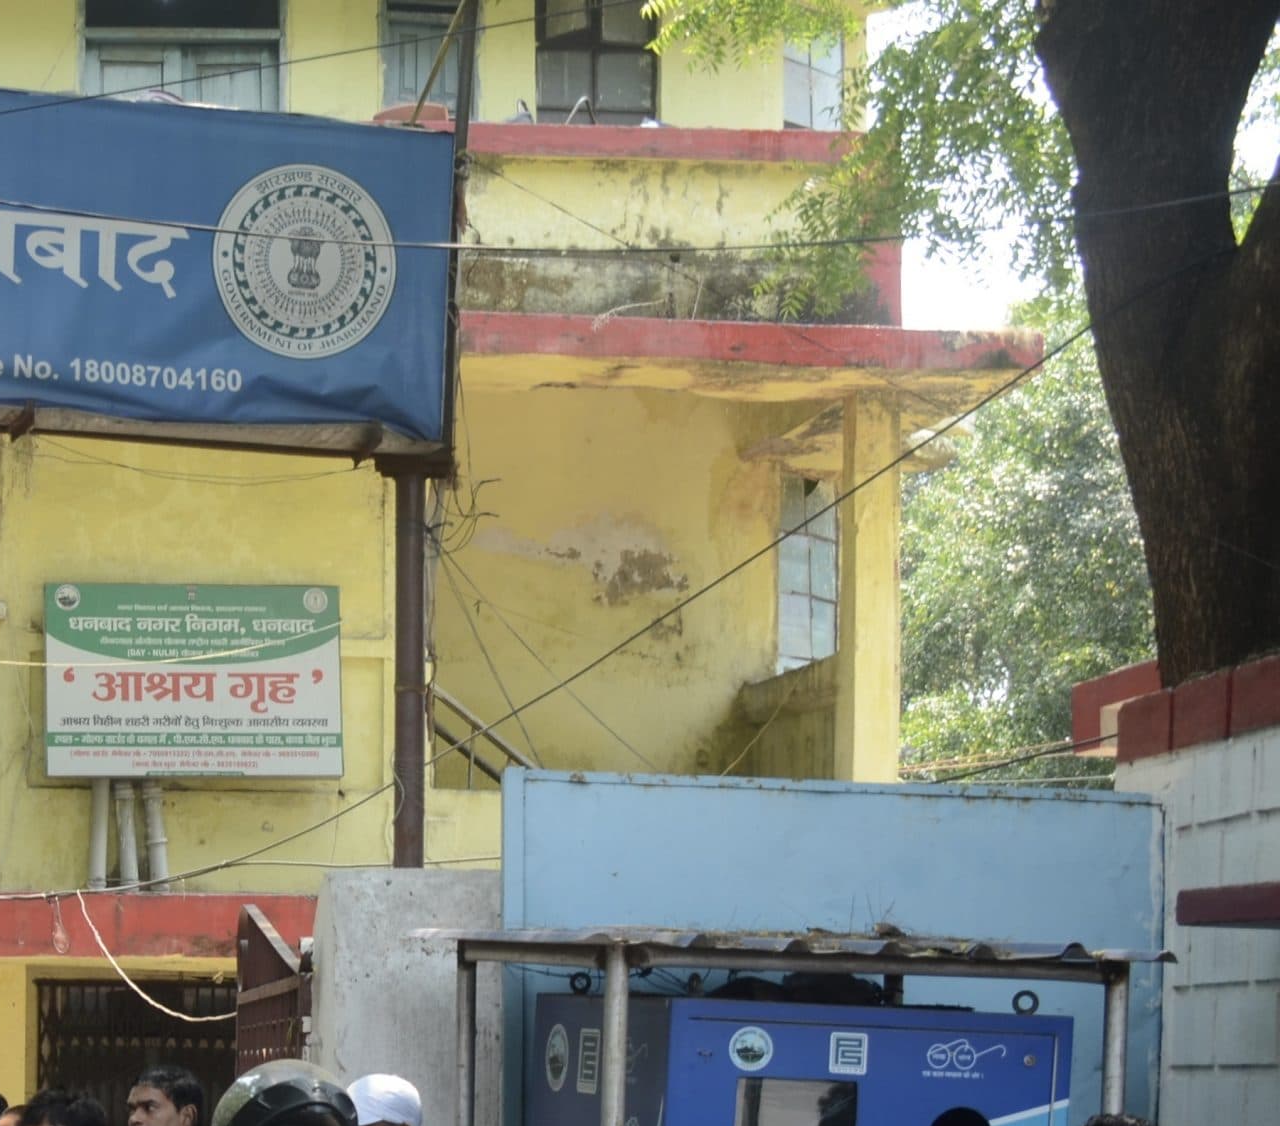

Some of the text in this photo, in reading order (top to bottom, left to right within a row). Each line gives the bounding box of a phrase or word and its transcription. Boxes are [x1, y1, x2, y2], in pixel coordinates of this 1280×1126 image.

[256, 171, 363, 204] झारखण्ड सरकार
[222, 269, 386, 352] GOVERNMENT OF JHARKHAND
[14, 354, 59, 381] No.
[70, 358, 242, 392] 18008704160
[69, 613, 315, 635] धनबाद नगर निगम, धनबाद
[91, 671, 217, 702] आश्रय
[227, 672, 300, 714] गृह
